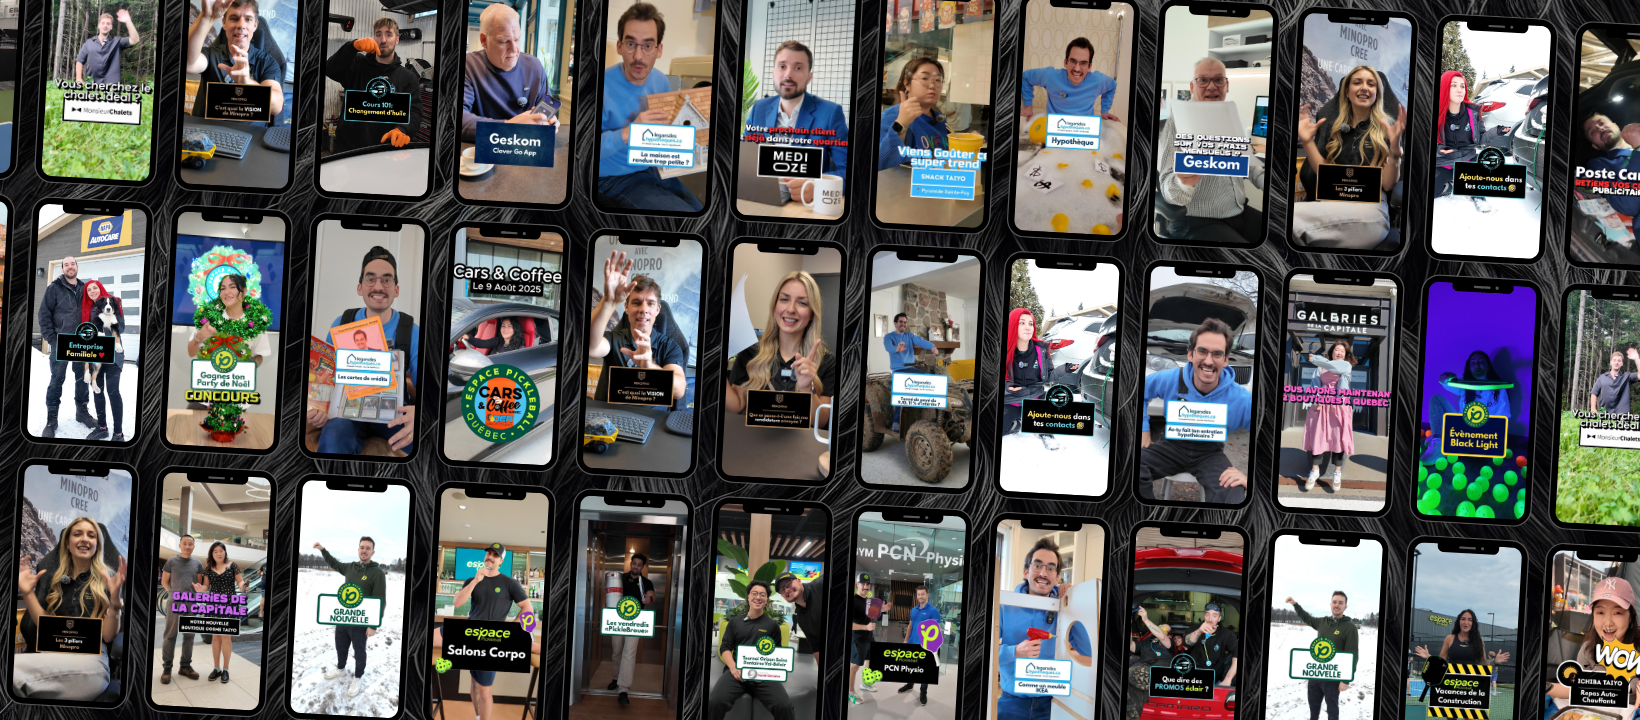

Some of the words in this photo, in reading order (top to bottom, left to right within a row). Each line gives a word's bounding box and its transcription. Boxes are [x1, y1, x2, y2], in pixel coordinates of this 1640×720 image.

[1340, 24, 1378, 51] MINOPRO
[1350, 44, 1368, 60] CREE
[1317, 58, 1333, 72] UNE
[100, 223, 112, 232] NAPA
[634, 246, 648, 256] AVEC
[1296, 310, 1379, 326] GALERIES
[1324, 324, 1368, 334] CAPITALE
[60, 476, 98, 502] MINOPRO
[70, 496, 88, 512] CREE
[38, 509, 54, 523] UNE
[878, 543, 917, 562] PCN
[1146, 702, 1212, 712] CAMARO
